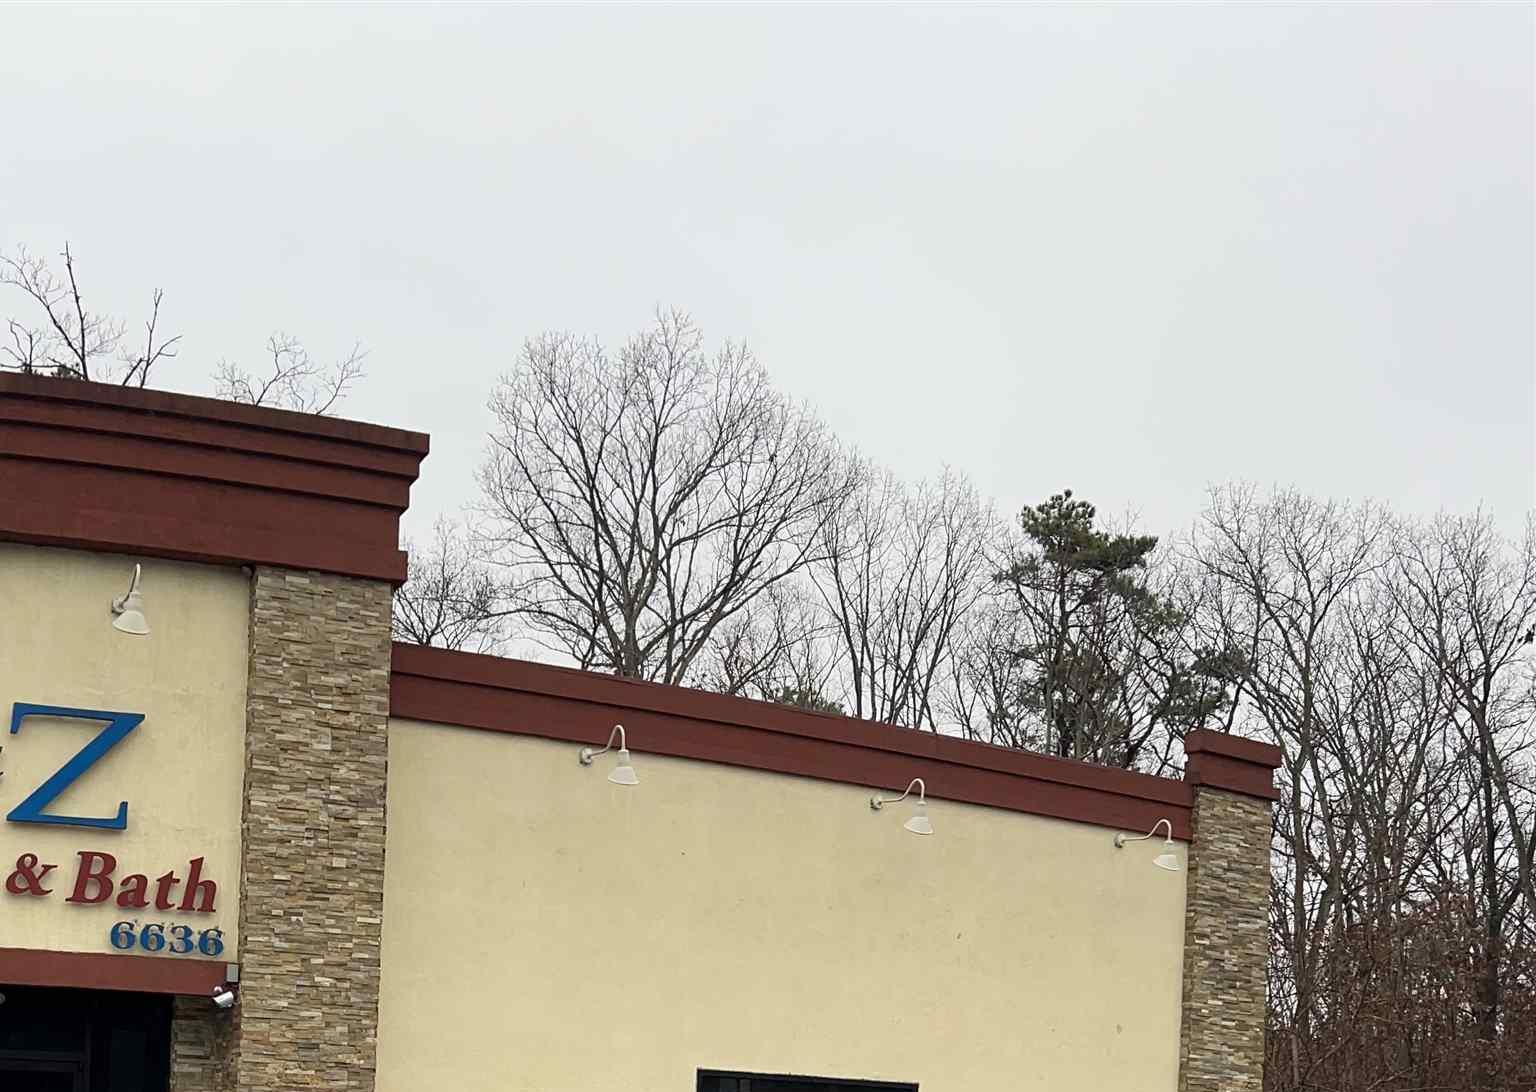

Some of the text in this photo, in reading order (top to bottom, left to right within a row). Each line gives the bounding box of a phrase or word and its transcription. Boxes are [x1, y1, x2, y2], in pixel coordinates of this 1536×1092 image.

[5, 852, 57, 897] &
[65, 850, 218, 913] Bath
[109, 919, 224, 957] 6636
